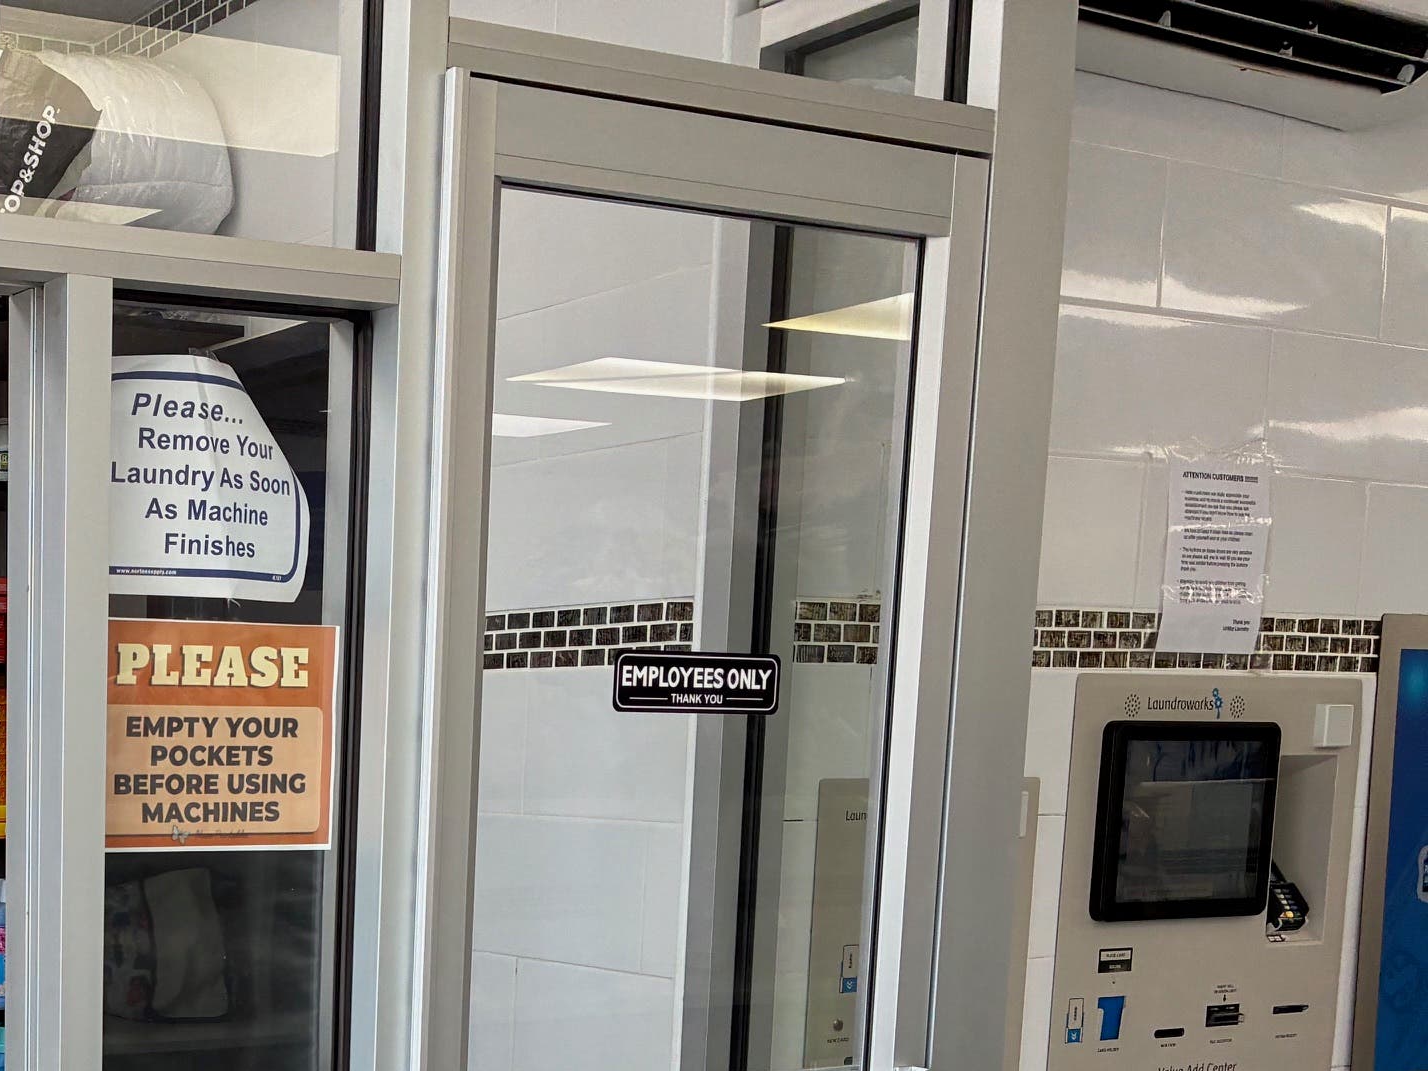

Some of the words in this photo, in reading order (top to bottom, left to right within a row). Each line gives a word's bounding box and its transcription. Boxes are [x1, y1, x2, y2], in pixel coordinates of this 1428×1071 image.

[0, 105, 57, 214] OP&SHOP
[131, 393, 243, 424] Please...
[138, 427, 229, 454] Remove
[236, 434, 273, 460] Your
[111, 461, 214, 492] Laundry
[220, 467, 243, 490] As
[249, 470, 290, 496] Soon
[145, 497, 178, 520] As
[187, 499, 268, 526] Machine
[164, 532, 255, 558] Finishes
[116, 642, 310, 688] PLEASE
[622, 665, 724, 690] EMPLOYEES
[727, 668, 772, 690] ONLY
[671, 693, 702, 704] THANK
[704, 694, 723, 705] YOU
[1147, 696, 1215, 713] Laundroworks
[126, 716, 218, 738] EMPTY
[225, 716, 299, 739] YOUR
[150, 745, 273, 767] POCKETS
[114, 774, 219, 795] BEFORE
[227, 773, 306, 794] USING
[141, 801, 280, 824] MACHINES
